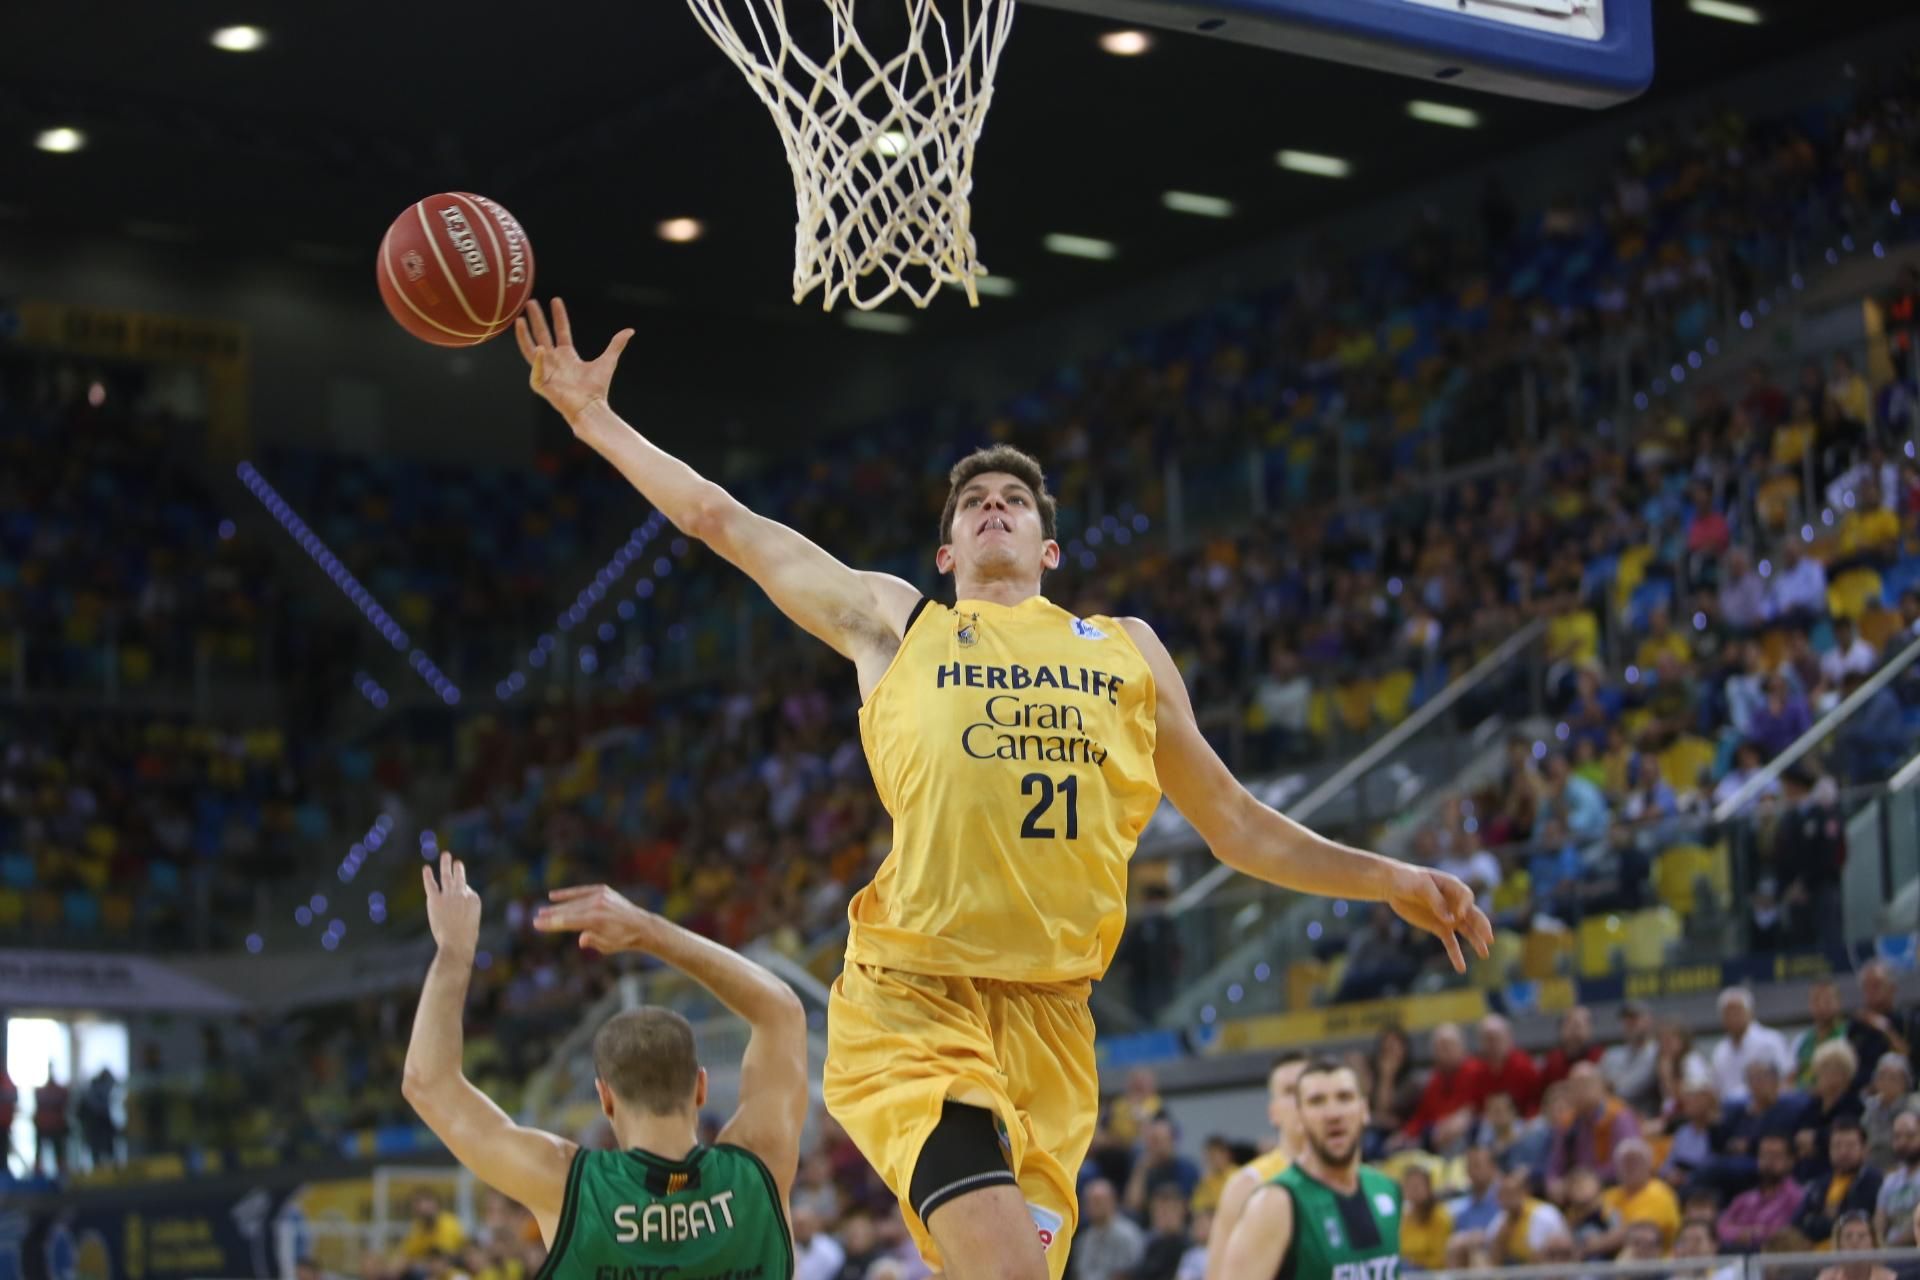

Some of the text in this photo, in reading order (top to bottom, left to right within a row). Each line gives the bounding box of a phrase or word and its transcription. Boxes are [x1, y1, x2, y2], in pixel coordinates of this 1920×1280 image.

[937, 661, 1124, 706] HERBALIFE
[985, 695, 1083, 731] Gran
[1020, 772, 1078, 840] 21
